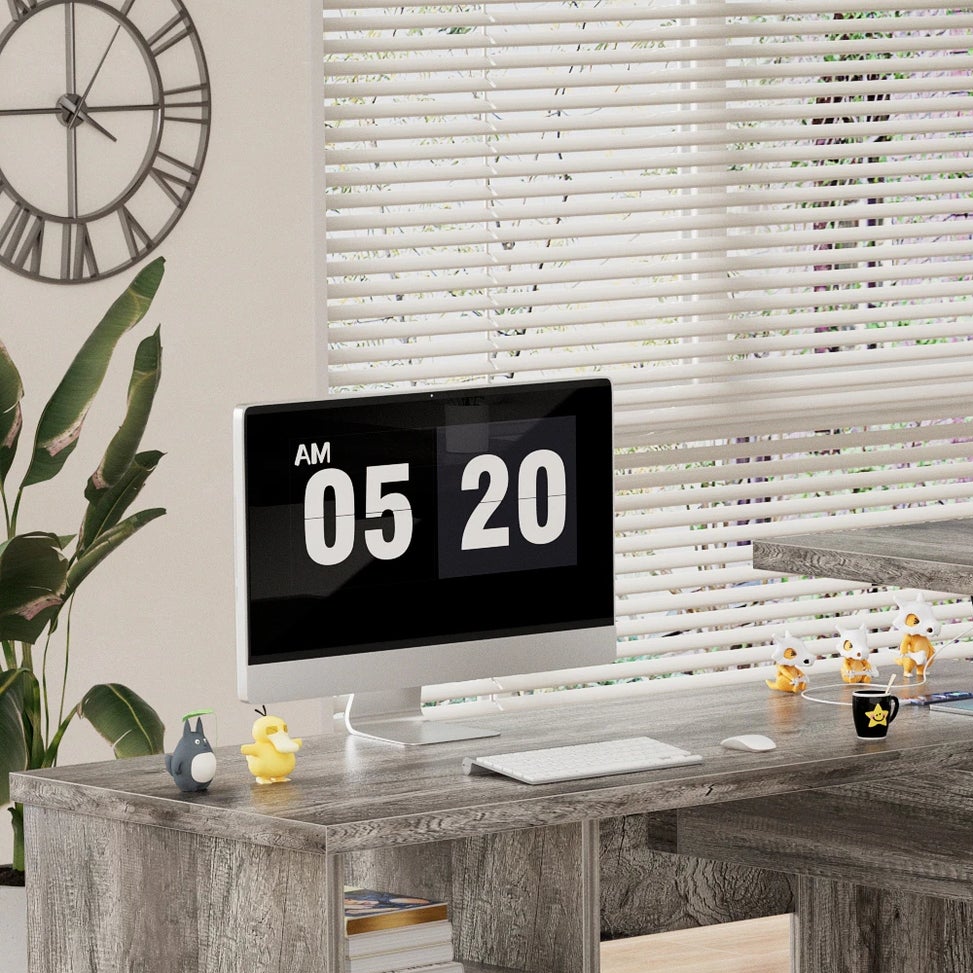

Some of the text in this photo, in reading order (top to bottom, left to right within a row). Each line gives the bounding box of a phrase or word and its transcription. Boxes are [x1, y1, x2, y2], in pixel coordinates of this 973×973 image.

[294, 441, 331, 466] AM
[304, 449, 567, 566] 05 20
